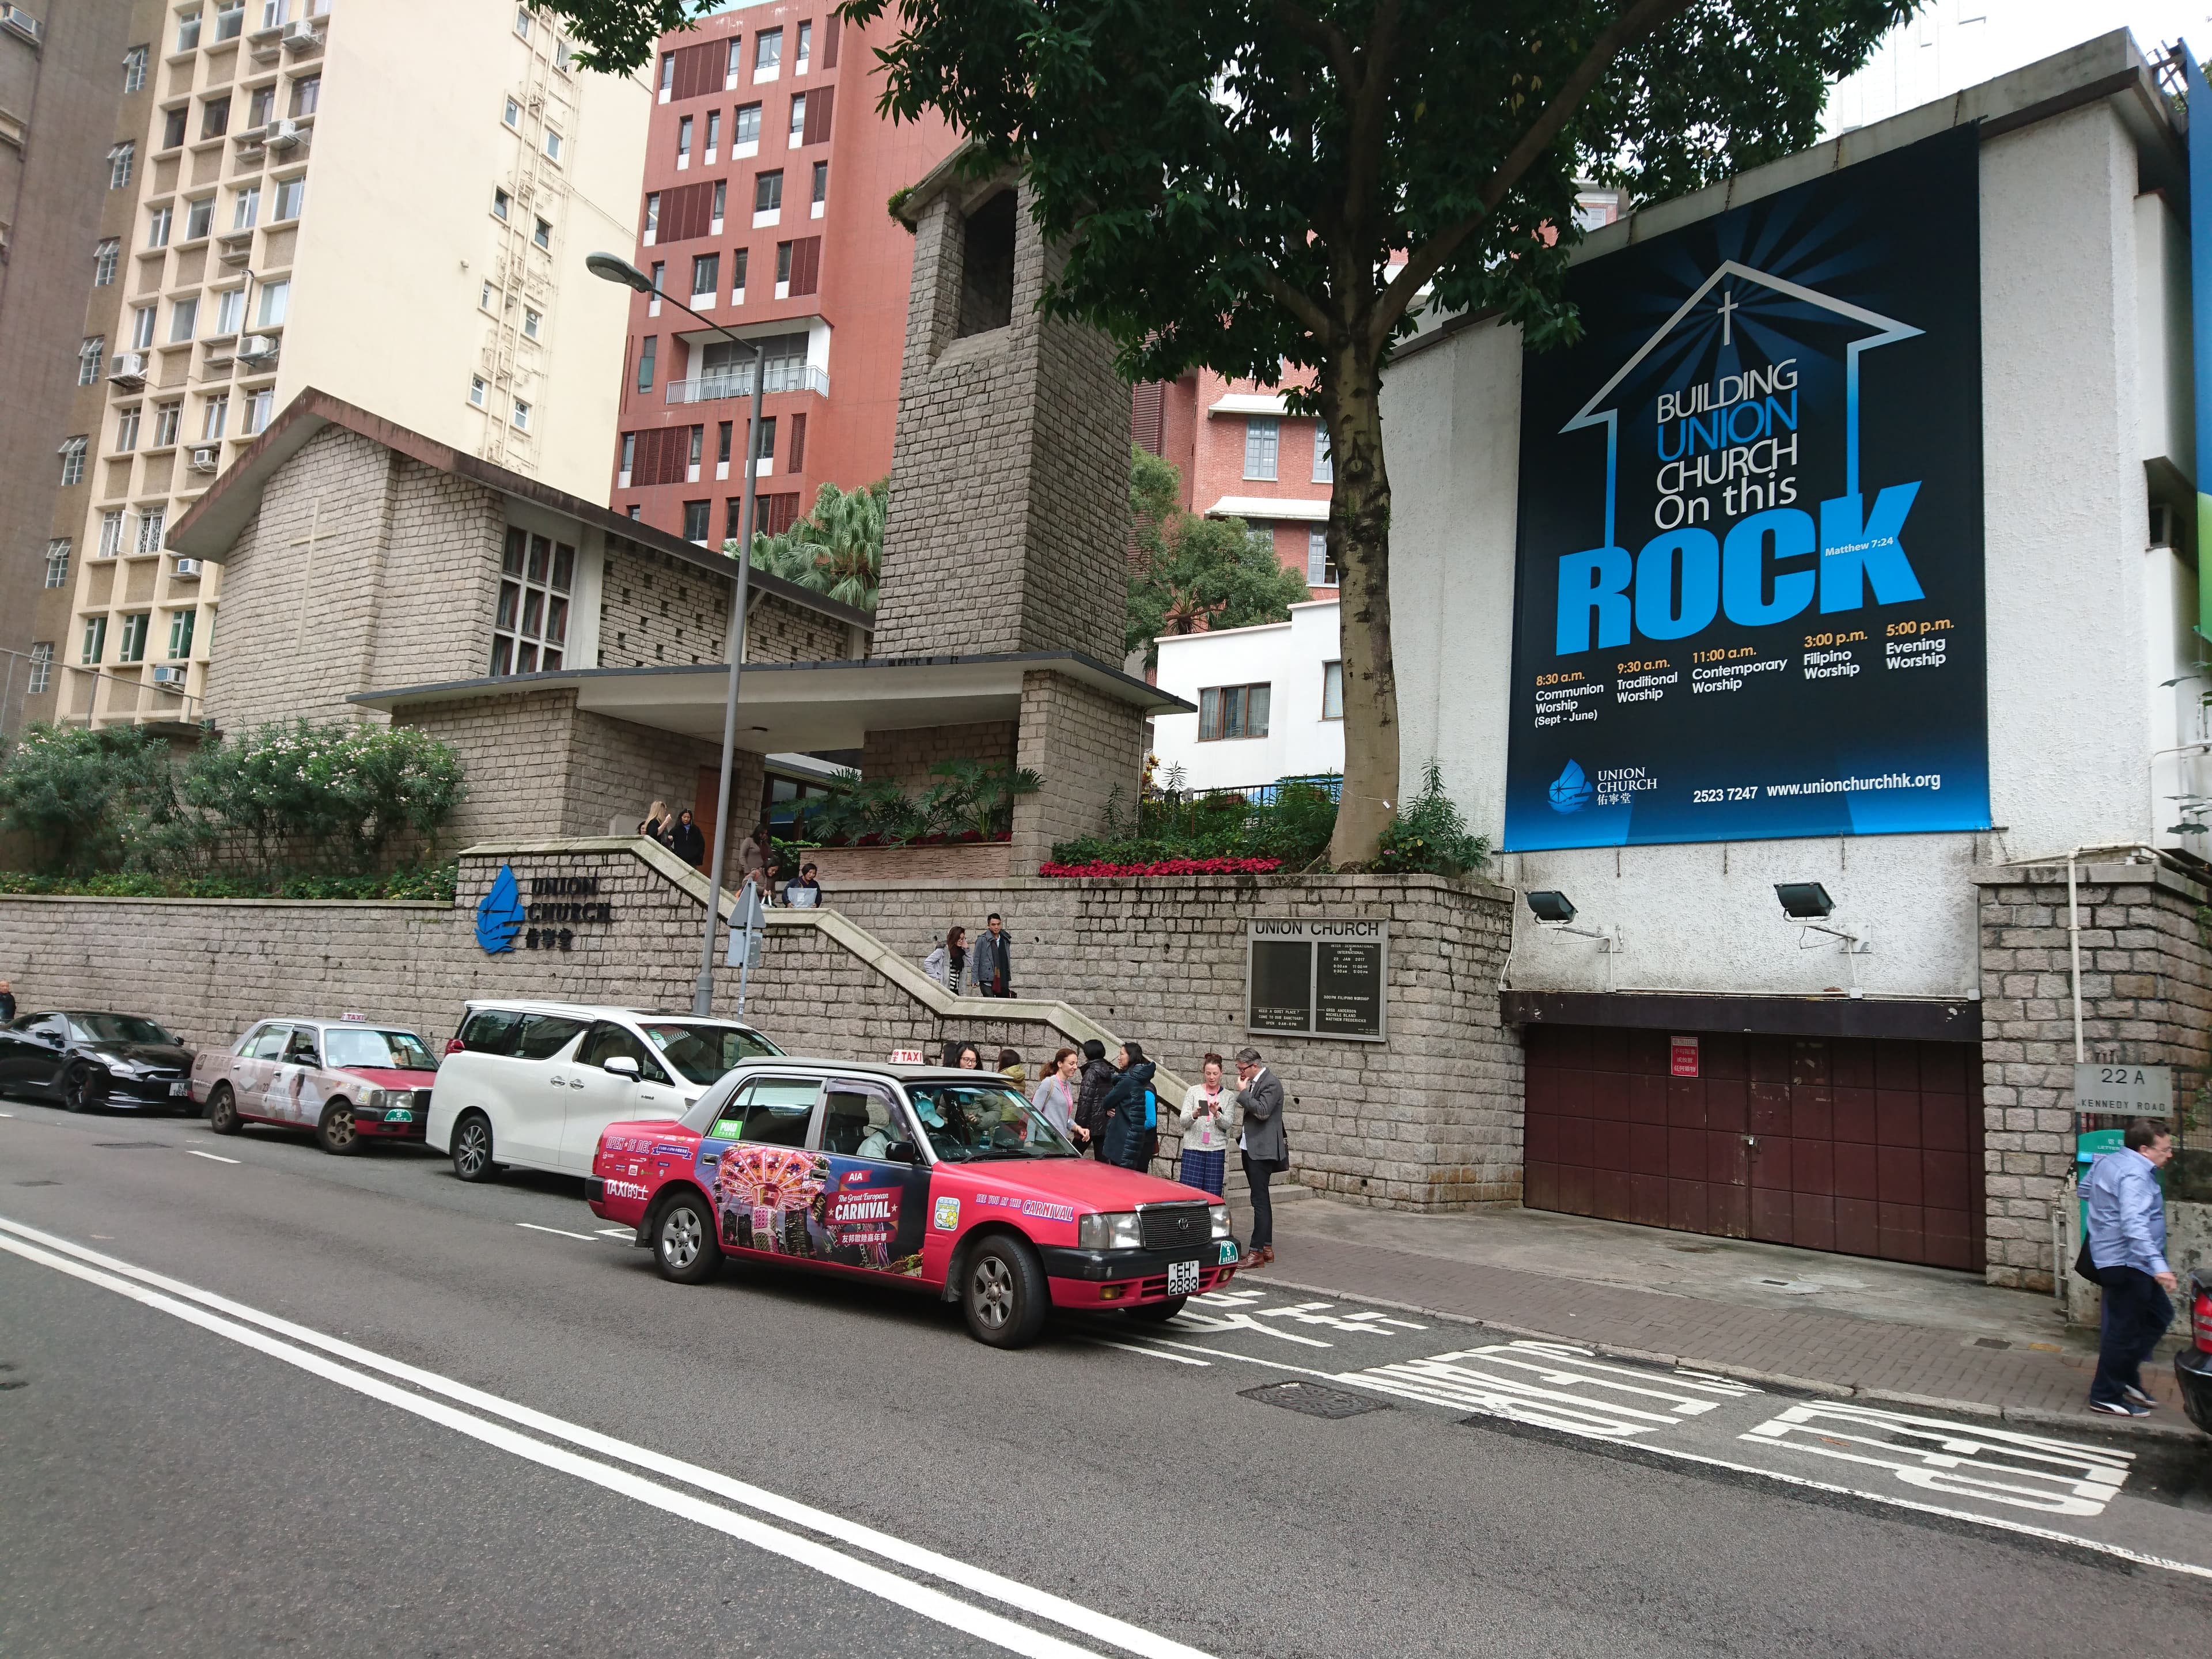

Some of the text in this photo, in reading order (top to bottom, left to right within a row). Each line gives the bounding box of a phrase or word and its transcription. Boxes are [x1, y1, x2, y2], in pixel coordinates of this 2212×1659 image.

[1657, 358, 1797, 424] BUILDING
[1658, 389, 1797, 461] UNION
[1656, 434, 1797, 495] CHURCH
[1654, 472, 1797, 529] On this
[1825, 536, 1894, 556] Matthew 7:24
[1556, 480, 1926, 656] ROCK
[1885, 618, 1955, 637] 5:00 p.m.
[1804, 629, 1868, 648] 3:00 p.m.
[1885, 638, 1946, 656] Evening
[1692, 645, 1757, 664] 11:00 a.m.
[1803, 649, 1853, 666] Filipino
[1885, 652, 1946, 671] Worship
[1617, 658, 1671, 675] 9:30 a.m.
[1692, 658, 1788, 680] Contemporary
[1804, 663, 1861, 680] Worship
[1536, 672, 1585, 687] 8:30 a.m.
[1617, 672, 1678, 691] Traditional
[1692, 677, 1743, 694] Worship
[1535, 684, 1604, 701] Communion
[1617, 688, 1664, 704] Worship
[1535, 699, 1578, 714] Worship
[1534, 715, 1561, 728] (Sept
[1569, 709, 1598, 722] June)
[1597, 767, 1646, 781] UNION
[1597, 778, 1658, 793] CHURCH
[1766, 772, 1941, 797] www.unionchurchhk.org
[1597, 793, 1631, 806] 佑寧堂
[1693, 786, 1758, 803] 2523 7247
[531, 876, 600, 894] UNION
[527, 902, 611, 921] CHURCH
[1255, 921, 1378, 936] UNION CHURCH
[902, 1051, 922, 1062] TAXI
[2081, 1099, 2166, 1112] KENNEDY ROAD
[720, 1122, 737, 1132] POAD
[607, 1137, 653, 1154] OPEN 16 DEC
[849, 1173, 863, 1181] AIA
[848, 1194, 863, 1203] Great
[863, 1192, 889, 1203] European
[835, 1201, 891, 1221] CARNIVAL
[976, 1194, 1074, 1222] SEE YOU AT THE CARNIVAL
[842, 1233, 888, 1243] 友邦歐陸嘉年華
[1226, 1247, 1230, 1256] 5
[1176, 1262, 1191, 1279] EH
[1169, 1276, 1198, 1296] 2833
[1738, 1399, 2136, 1517] KEEP
